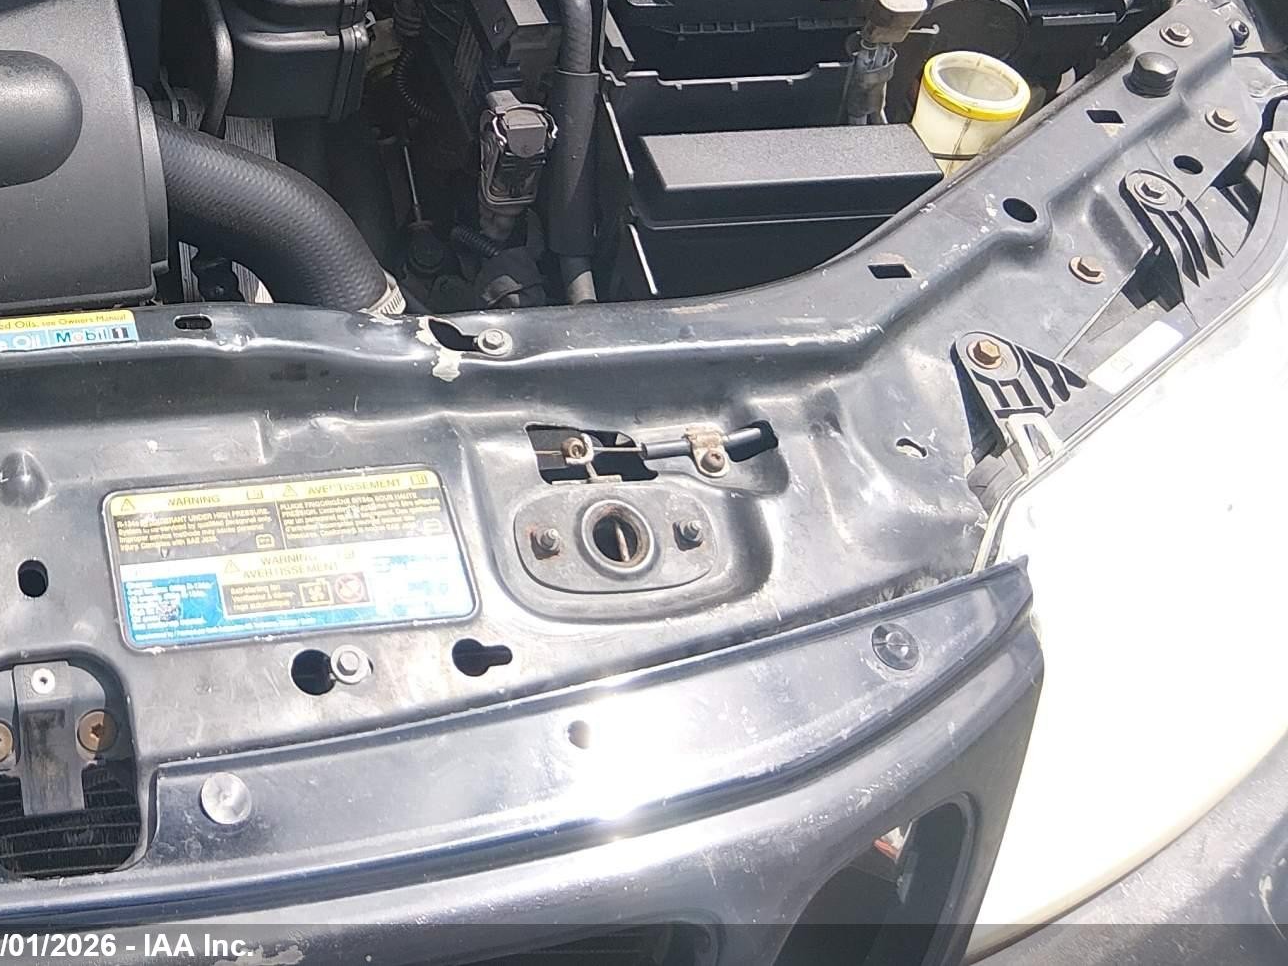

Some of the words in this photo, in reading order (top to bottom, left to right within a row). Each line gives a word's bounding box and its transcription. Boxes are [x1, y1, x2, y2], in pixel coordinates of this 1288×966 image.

[12, 335, 41, 350] Oil
[55, 329, 108, 343] Mobil
[307, 479, 401, 496] AVETISSEMENT
